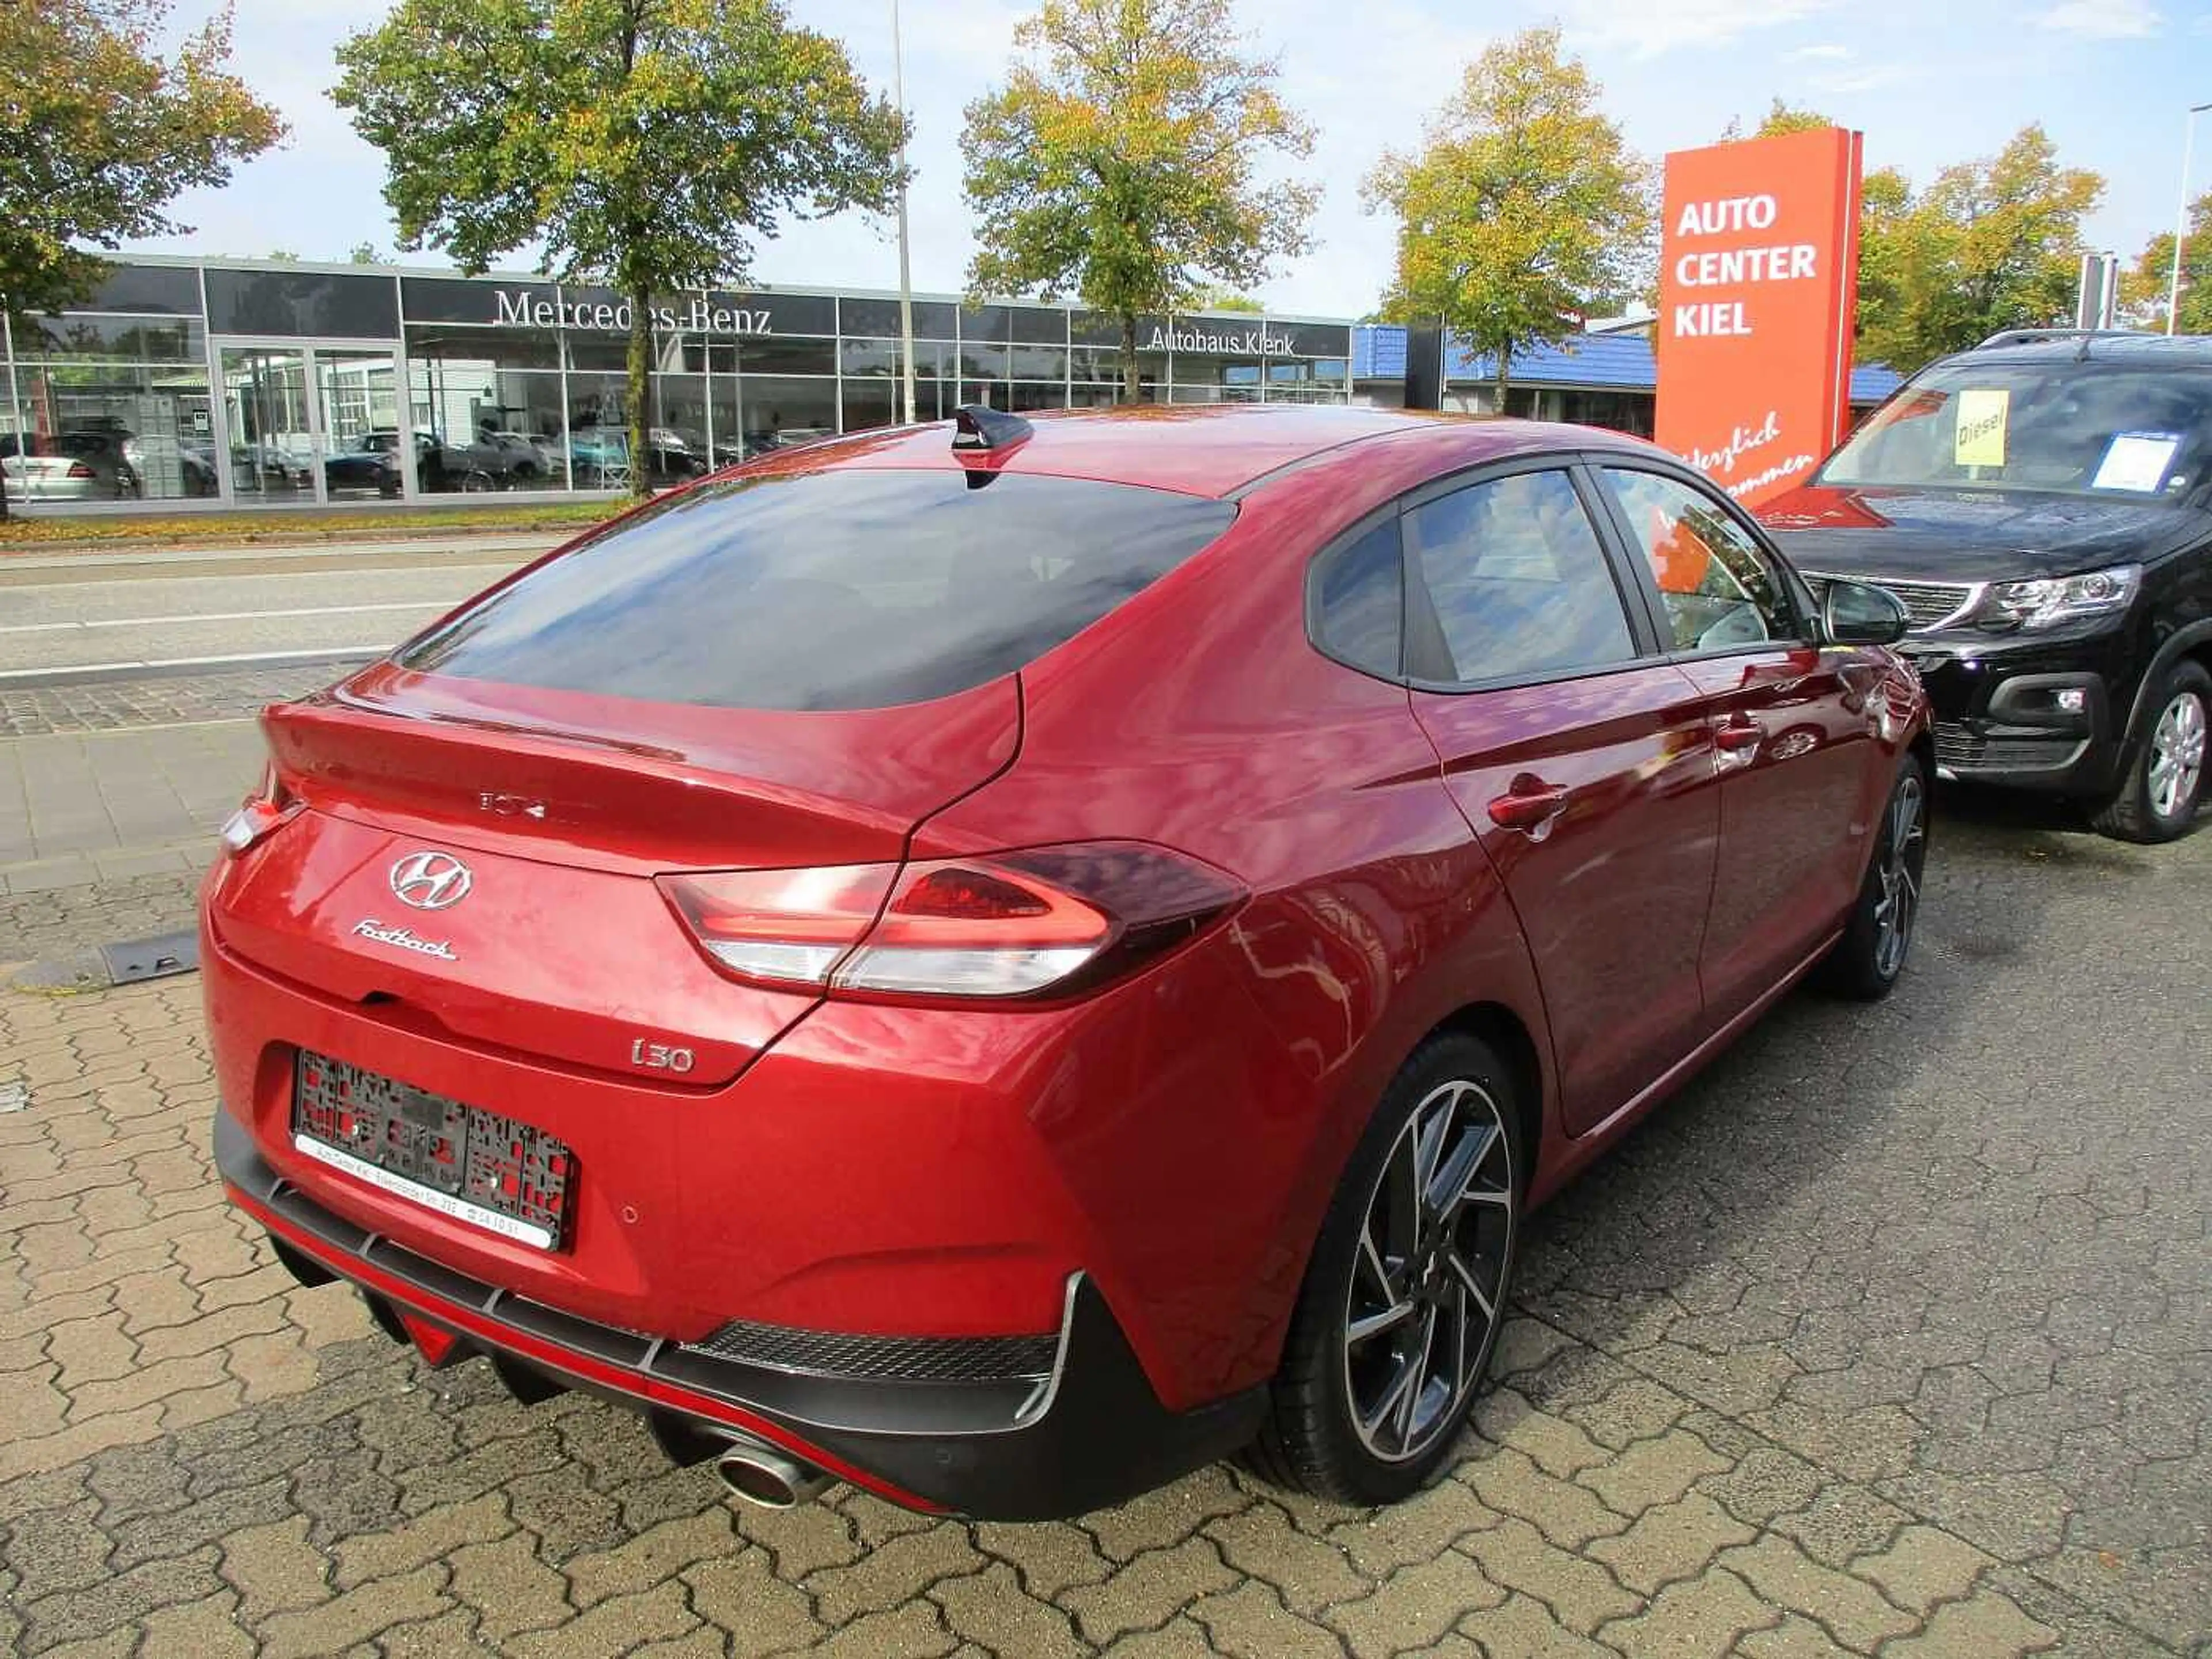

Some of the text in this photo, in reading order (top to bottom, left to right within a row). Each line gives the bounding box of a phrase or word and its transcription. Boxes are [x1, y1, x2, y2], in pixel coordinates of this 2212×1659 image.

[1677, 195, 1776, 237] AUTO
[1676, 245, 1816, 286] CENTER
[1675, 302, 1753, 337] KIEL
[1152, 327, 1294, 355] Autohaus Klenk
[1959, 404, 2004, 445] Diesel
[352, 919, 460, 960] Fastback
